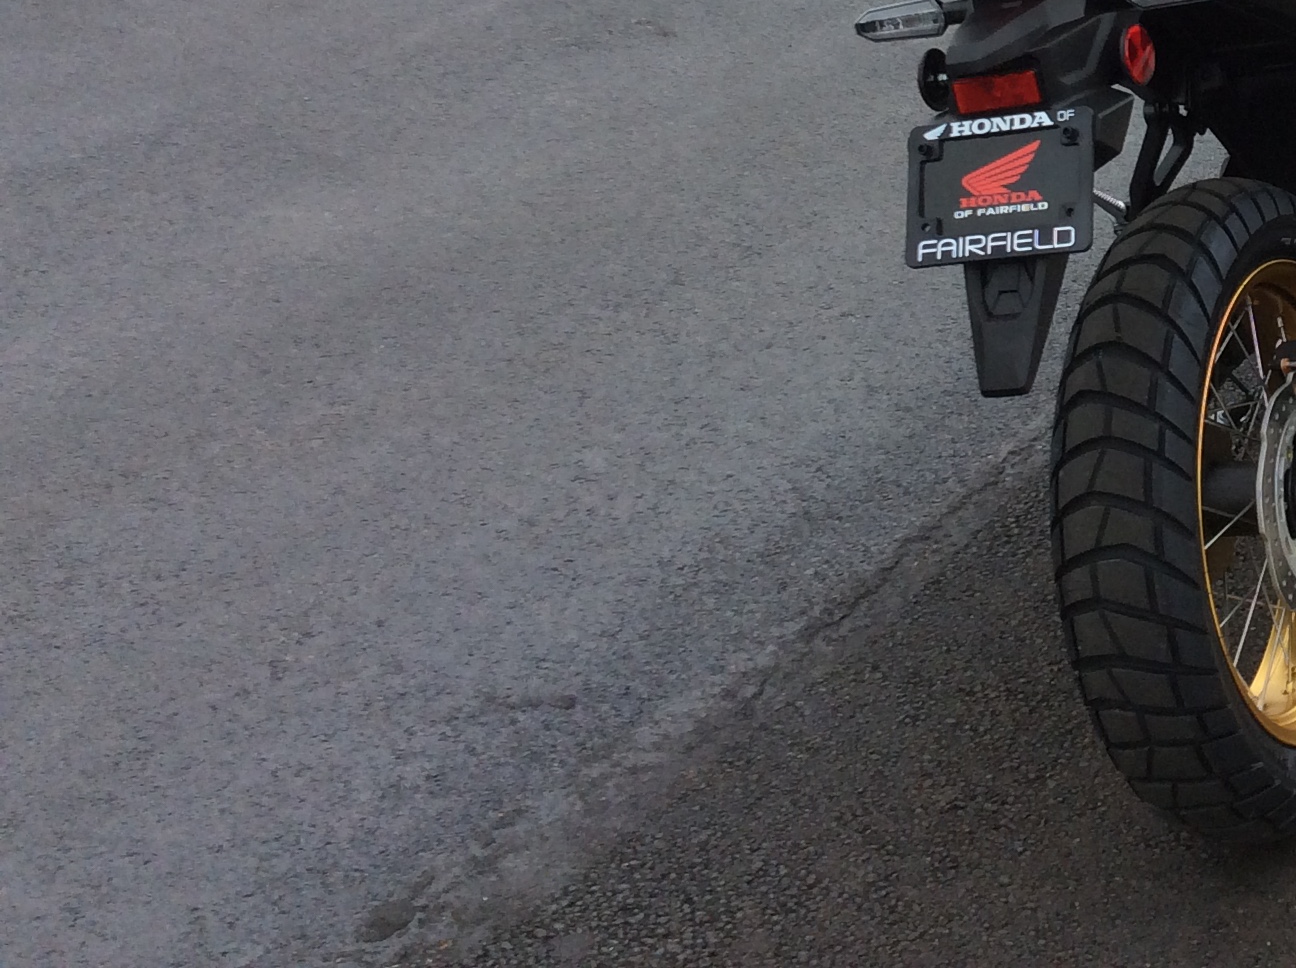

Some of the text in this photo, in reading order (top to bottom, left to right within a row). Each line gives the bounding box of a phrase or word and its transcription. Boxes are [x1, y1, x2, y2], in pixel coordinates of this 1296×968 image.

[949, 109, 1075, 138] HONDA OF
[953, 202, 1048, 219] OF FAIRFIELD
[959, 190, 1043, 208] HONDA
[917, 226, 1076, 262] FAIRFIELD
